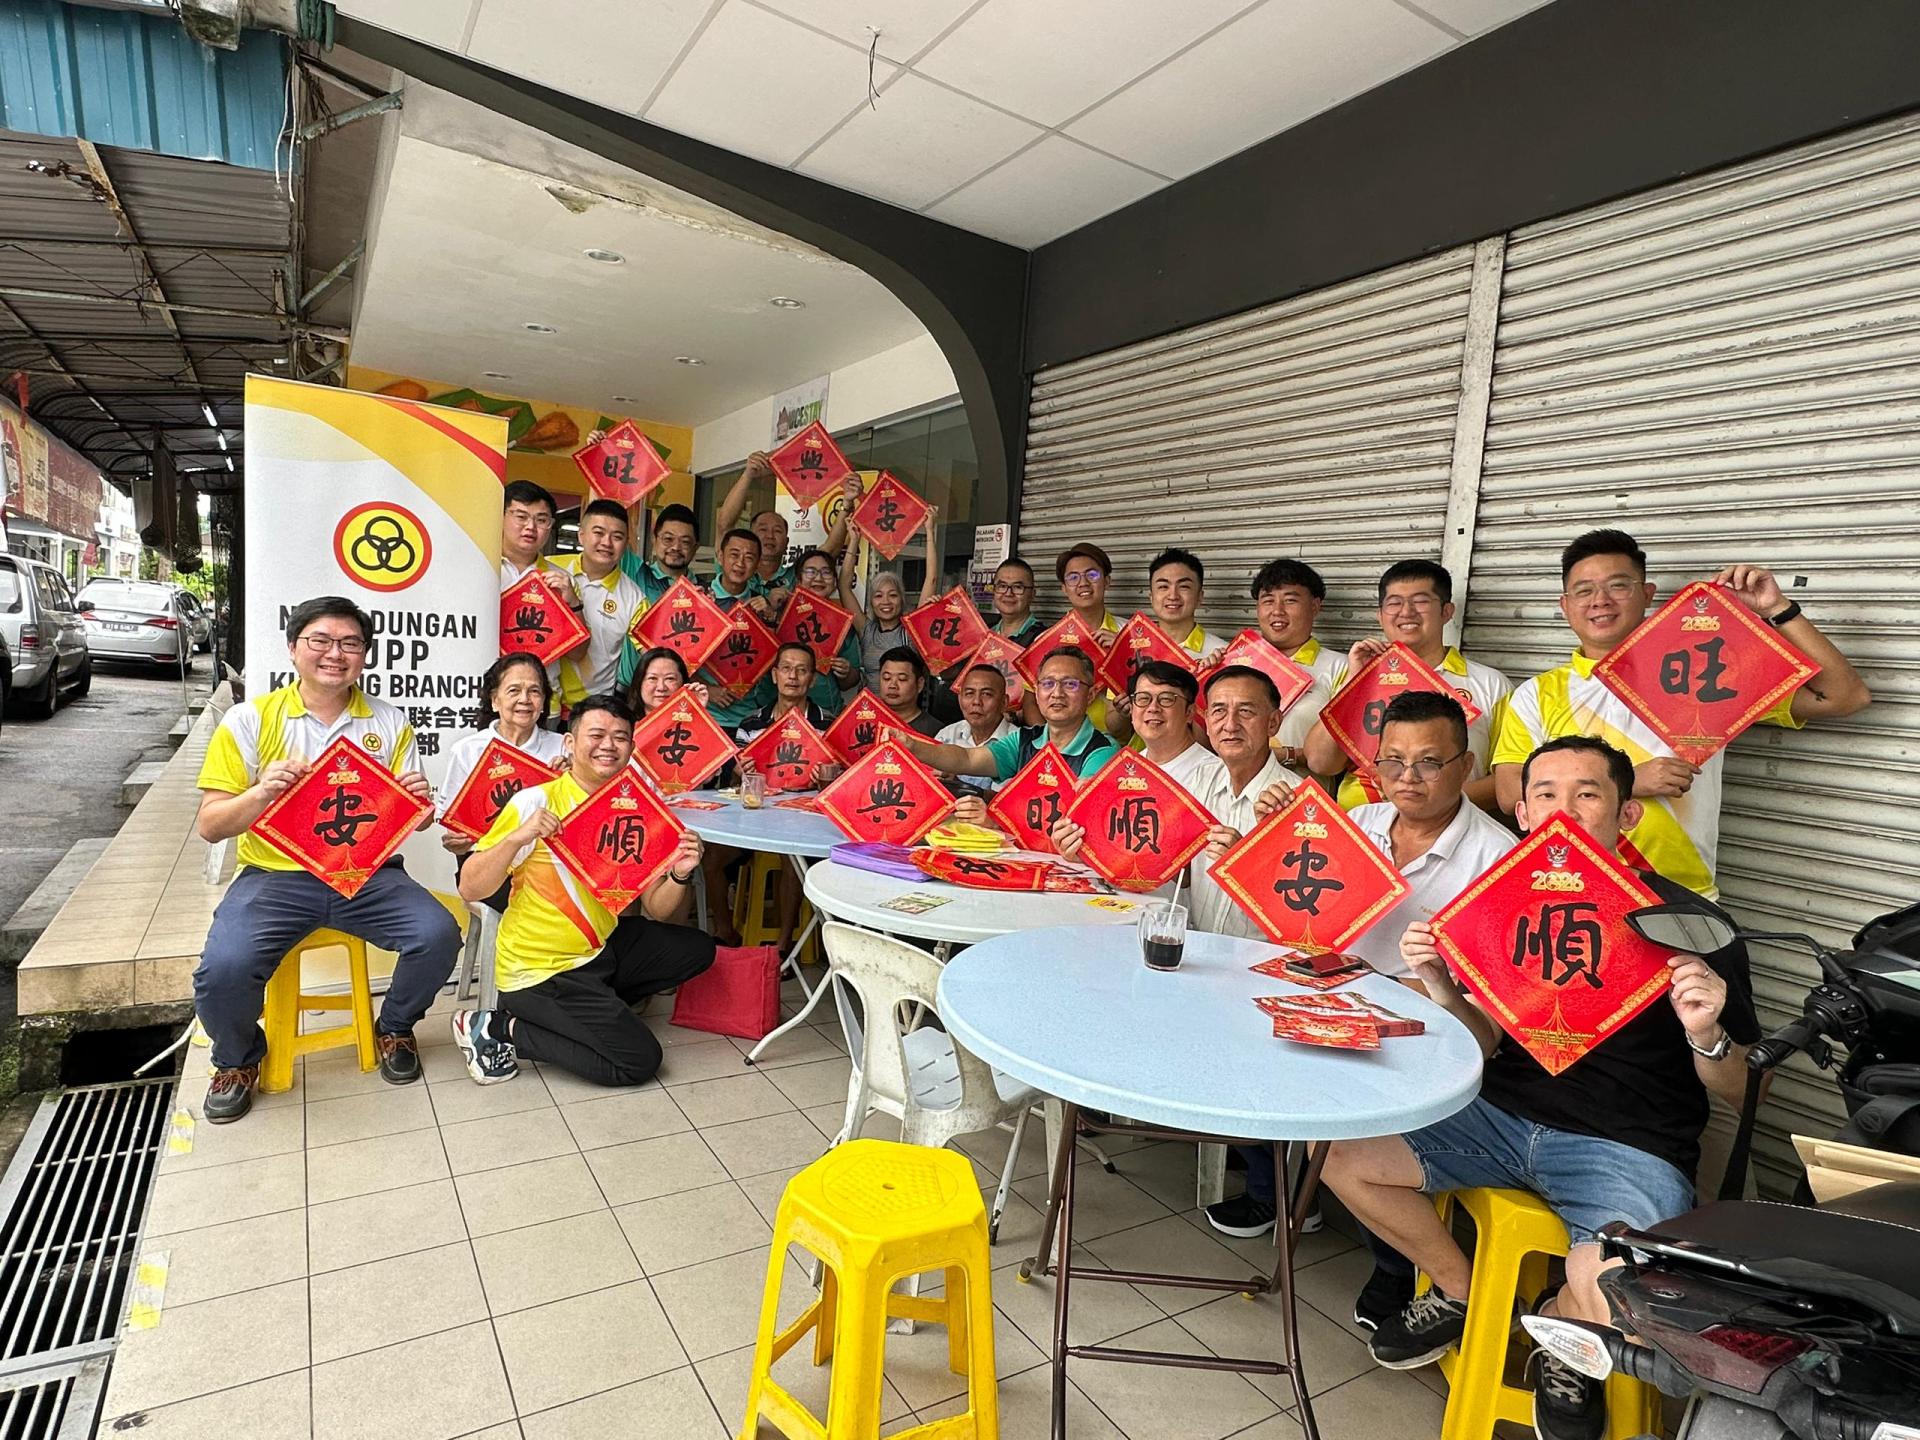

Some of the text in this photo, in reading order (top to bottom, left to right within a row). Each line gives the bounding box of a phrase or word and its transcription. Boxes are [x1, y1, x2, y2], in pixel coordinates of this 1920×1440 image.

[603, 452, 639, 484] 旺
[794, 519, 811, 529] GPS
[371, 610, 477, 639] DUNGAN
[795, 611, 832, 644] 旺
[929, 615, 962, 647] 旺
[1680, 615, 1721, 632] 2026
[364, 638, 429, 671] UPP
[1659, 636, 1738, 703] 旺
[389, 674, 482, 698] BRANCH
[400, 706, 481, 729] 联合党
[657, 722, 700, 767] 安
[327, 771, 361, 785] 2026
[313, 785, 379, 847] 安
[1107, 797, 1161, 854] 順
[1292, 821, 1329, 839] 2026
[596, 814, 645, 865] 順
[1273, 839, 1345, 917] 安
[1530, 870, 1585, 893] 2026
[1512, 902, 1604, 990] 順
